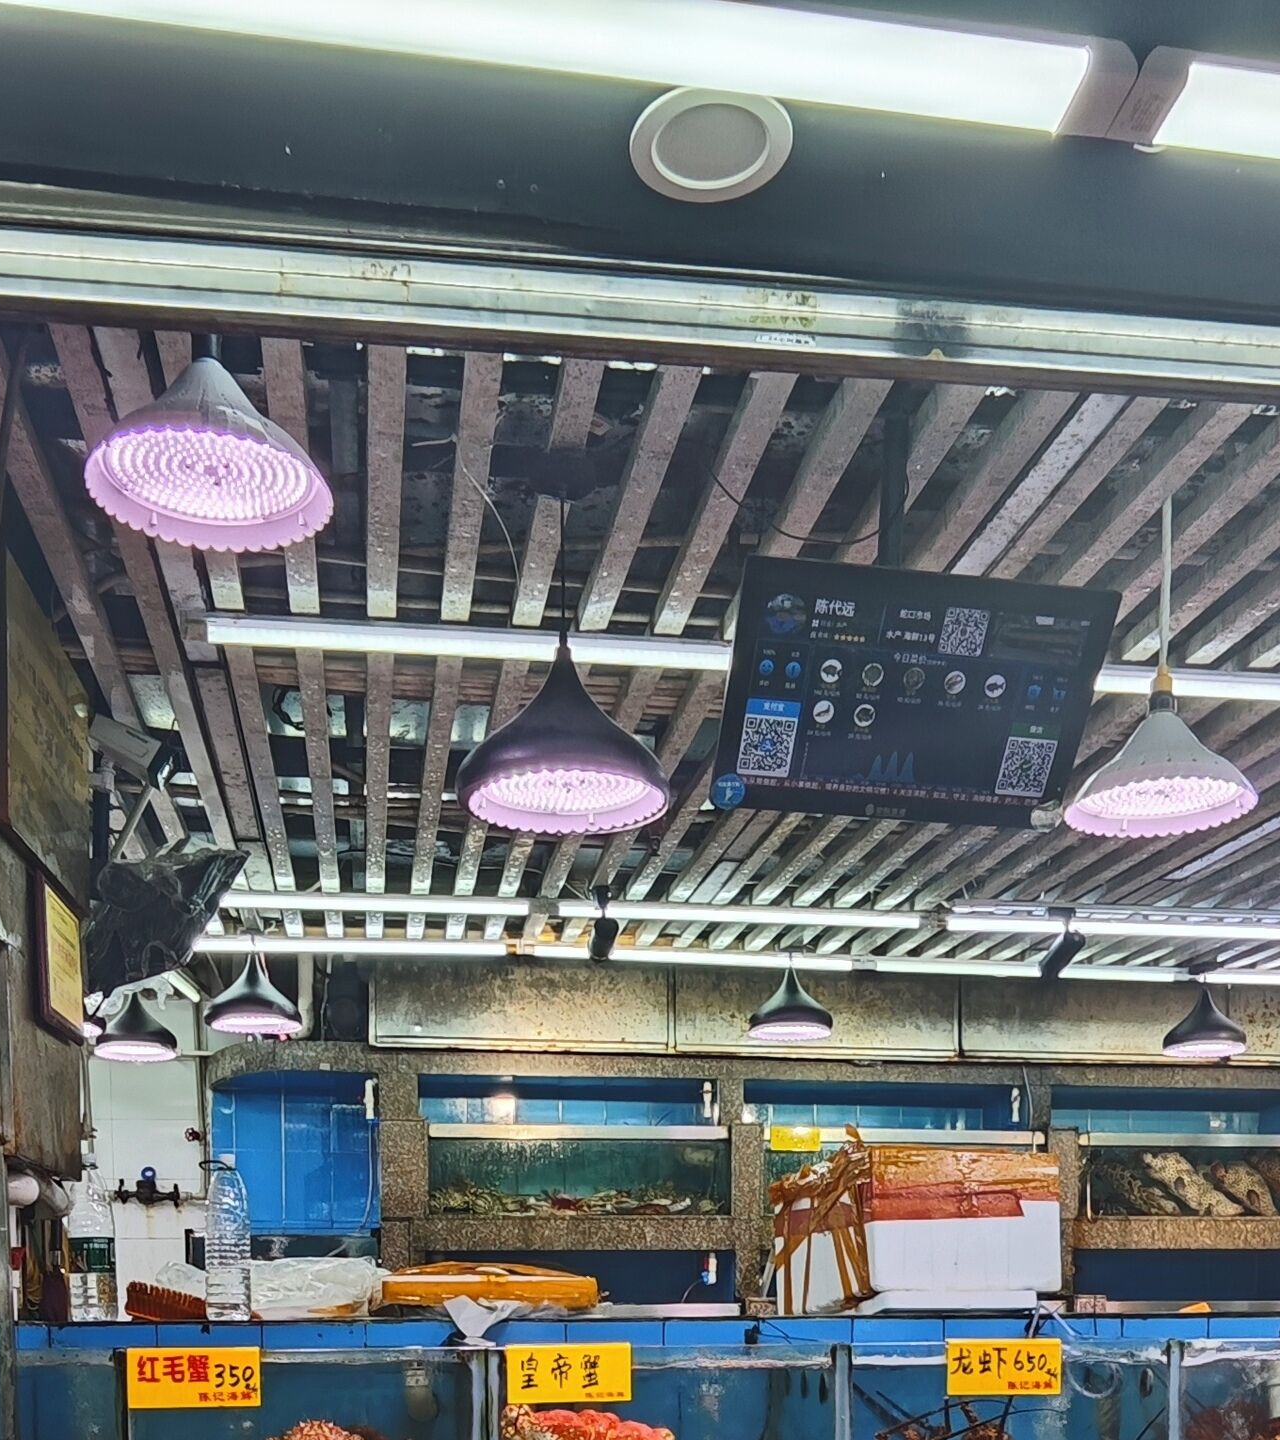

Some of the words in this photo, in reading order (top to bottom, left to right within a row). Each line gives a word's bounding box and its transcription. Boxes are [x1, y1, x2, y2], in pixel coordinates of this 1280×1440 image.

[815, 599, 856, 617] 陈代远
[137, 1355, 210, 1383] 红毛蟹
[520, 1352, 600, 1390] 皇帝蟹
